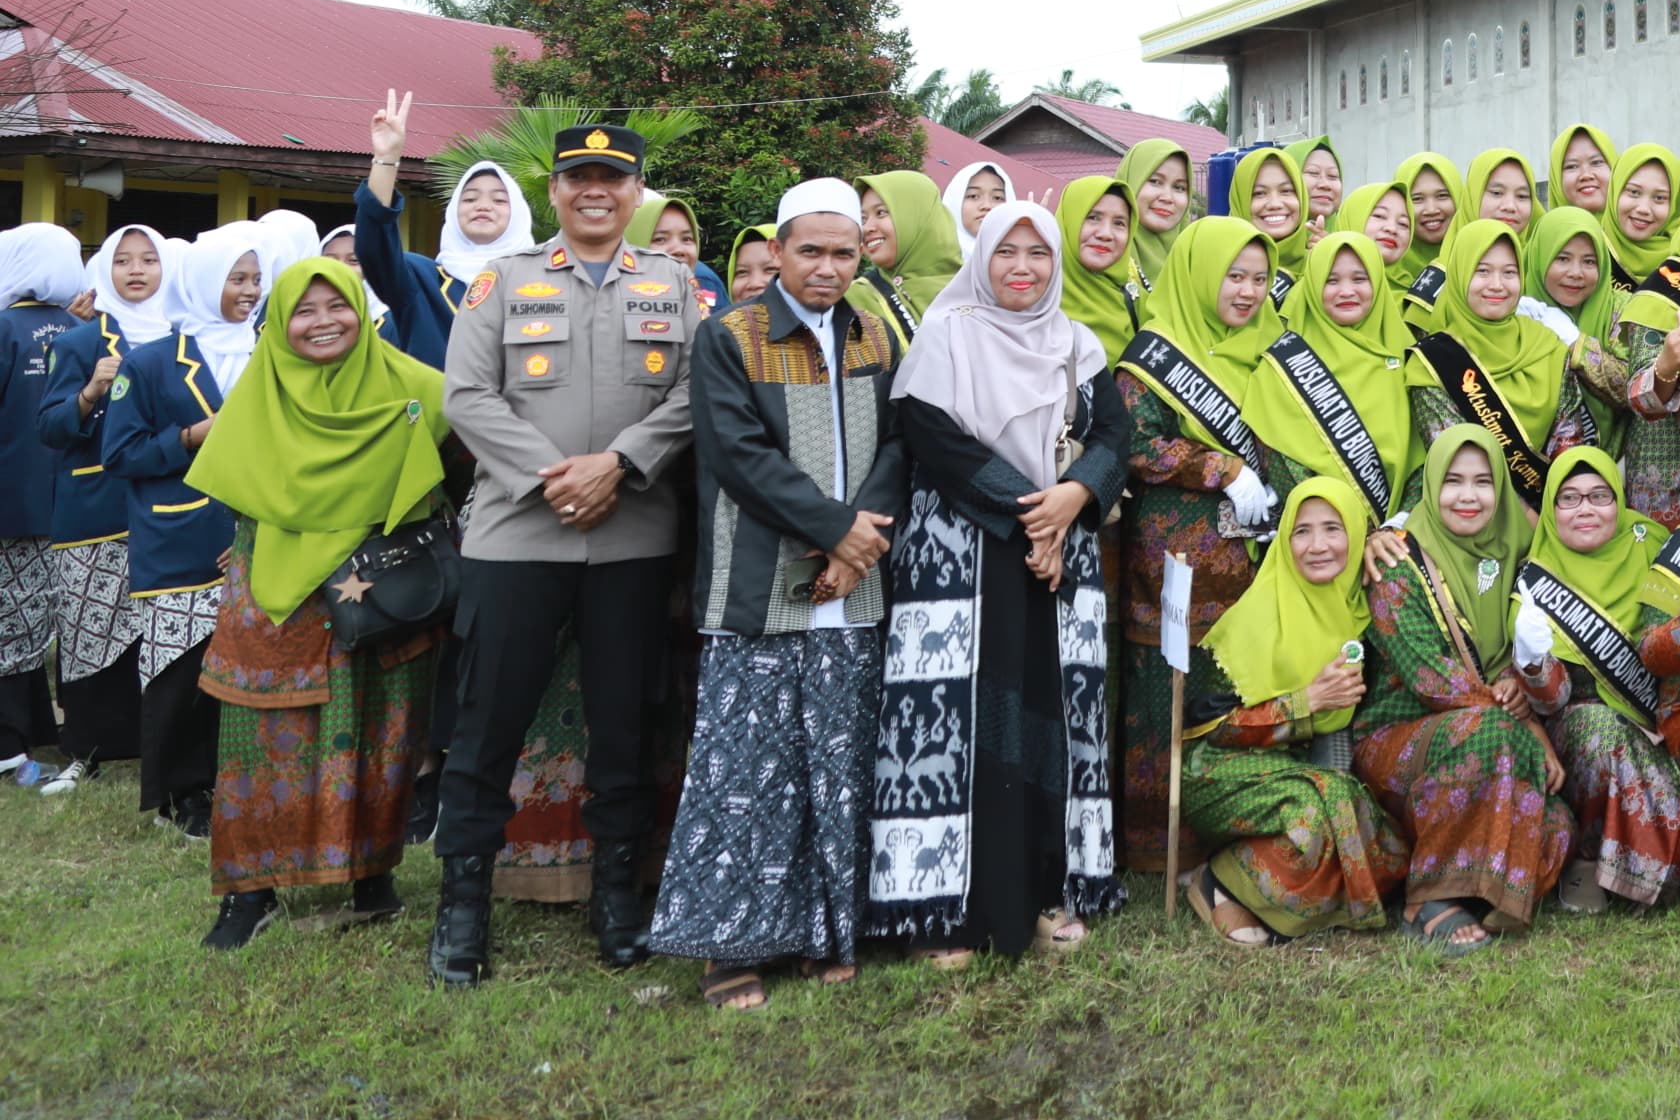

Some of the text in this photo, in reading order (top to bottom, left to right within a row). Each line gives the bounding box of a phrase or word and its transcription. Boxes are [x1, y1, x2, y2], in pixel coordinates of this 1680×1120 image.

[626, 300, 679, 314] POLRI
[1163, 360, 1238, 430] MUSLIMAT
[1222, 415, 1249, 447] NU
[1285, 349, 1349, 420] MUSLIMAT
[1327, 409, 1361, 440] NU
[1529, 575, 1605, 643] MUSLIMAT
[1589, 628, 1622, 661] NU
